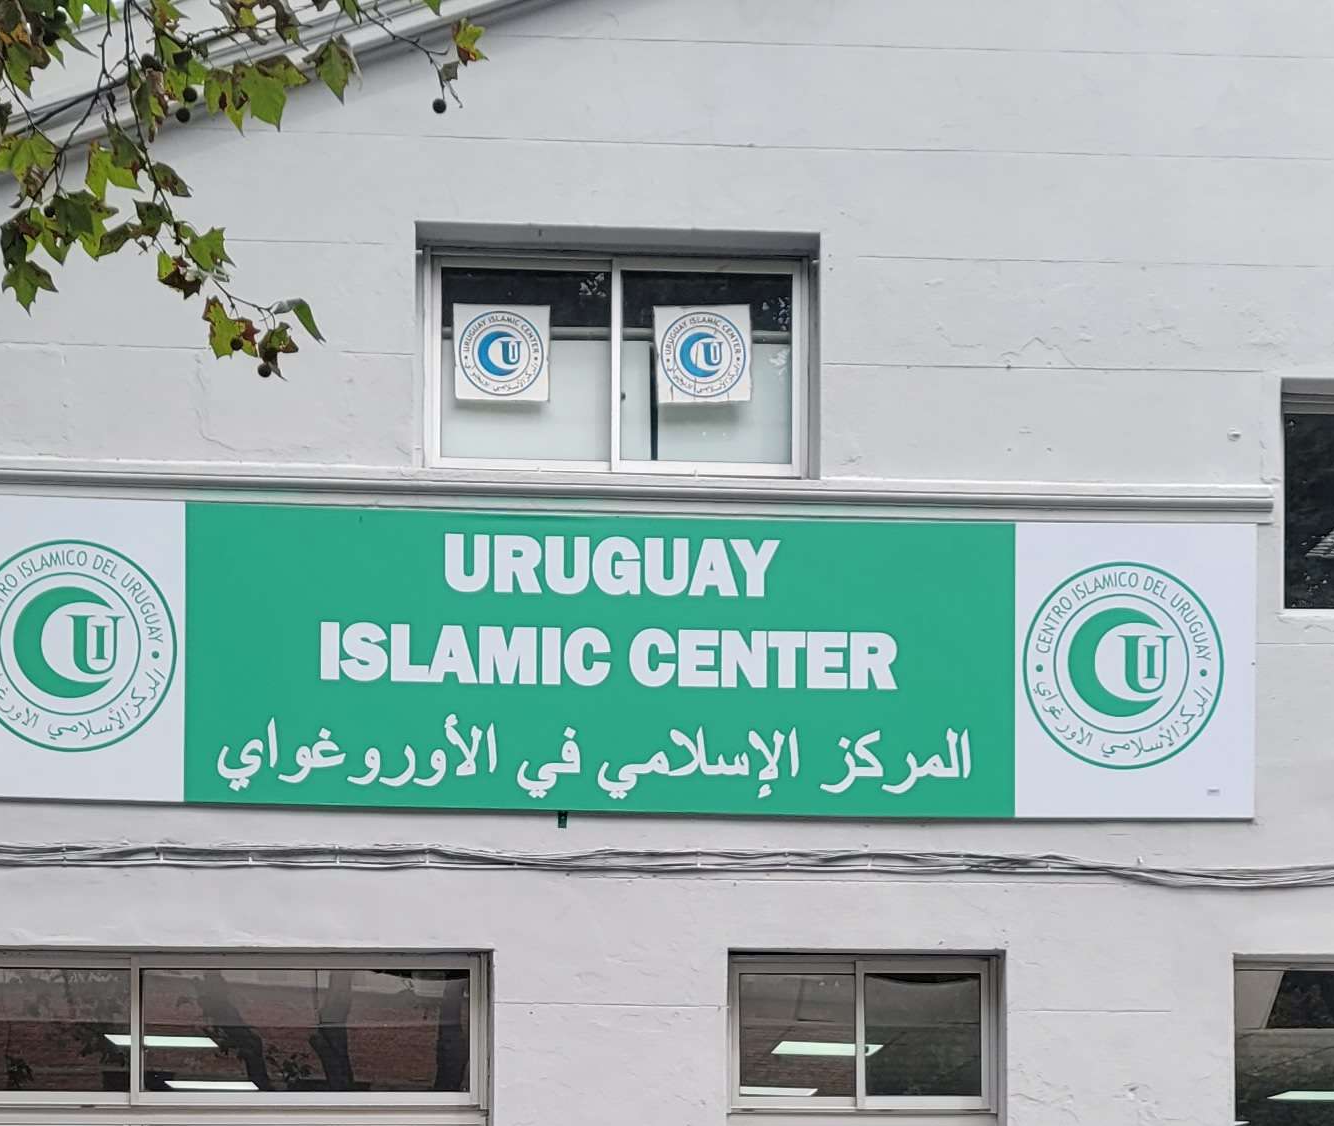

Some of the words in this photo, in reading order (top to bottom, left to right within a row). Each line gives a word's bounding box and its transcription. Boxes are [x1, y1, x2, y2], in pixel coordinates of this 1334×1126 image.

[488, 315, 521, 327] ISLAMIC
[521, 323, 540, 353] CENTER
[689, 316, 721, 327] ISLAMIC
[722, 324, 742, 354] CENTER
[17, 549, 87, 578] ISLAMICO
[92, 554, 117, 579] DEL
[120, 572, 164, 644] URUGUAY
[444, 533, 780, 597] URUGUAY
[1036, 596, 1072, 653] CENTRO
[1072, 572, 1139, 601] ISLAMICO
[1143, 575, 1167, 600] DEL
[1170, 593, 1212, 661] URUGUAY
[319, 622, 612, 686] ISLAMIC
[629, 629, 898, 690] CENTER
[217, 713, 497, 791] الأوروغواي
[516, 728, 581, 799] في
[597, 727, 800, 799] الإسلامي
[820, 728, 972, 796] المركز
